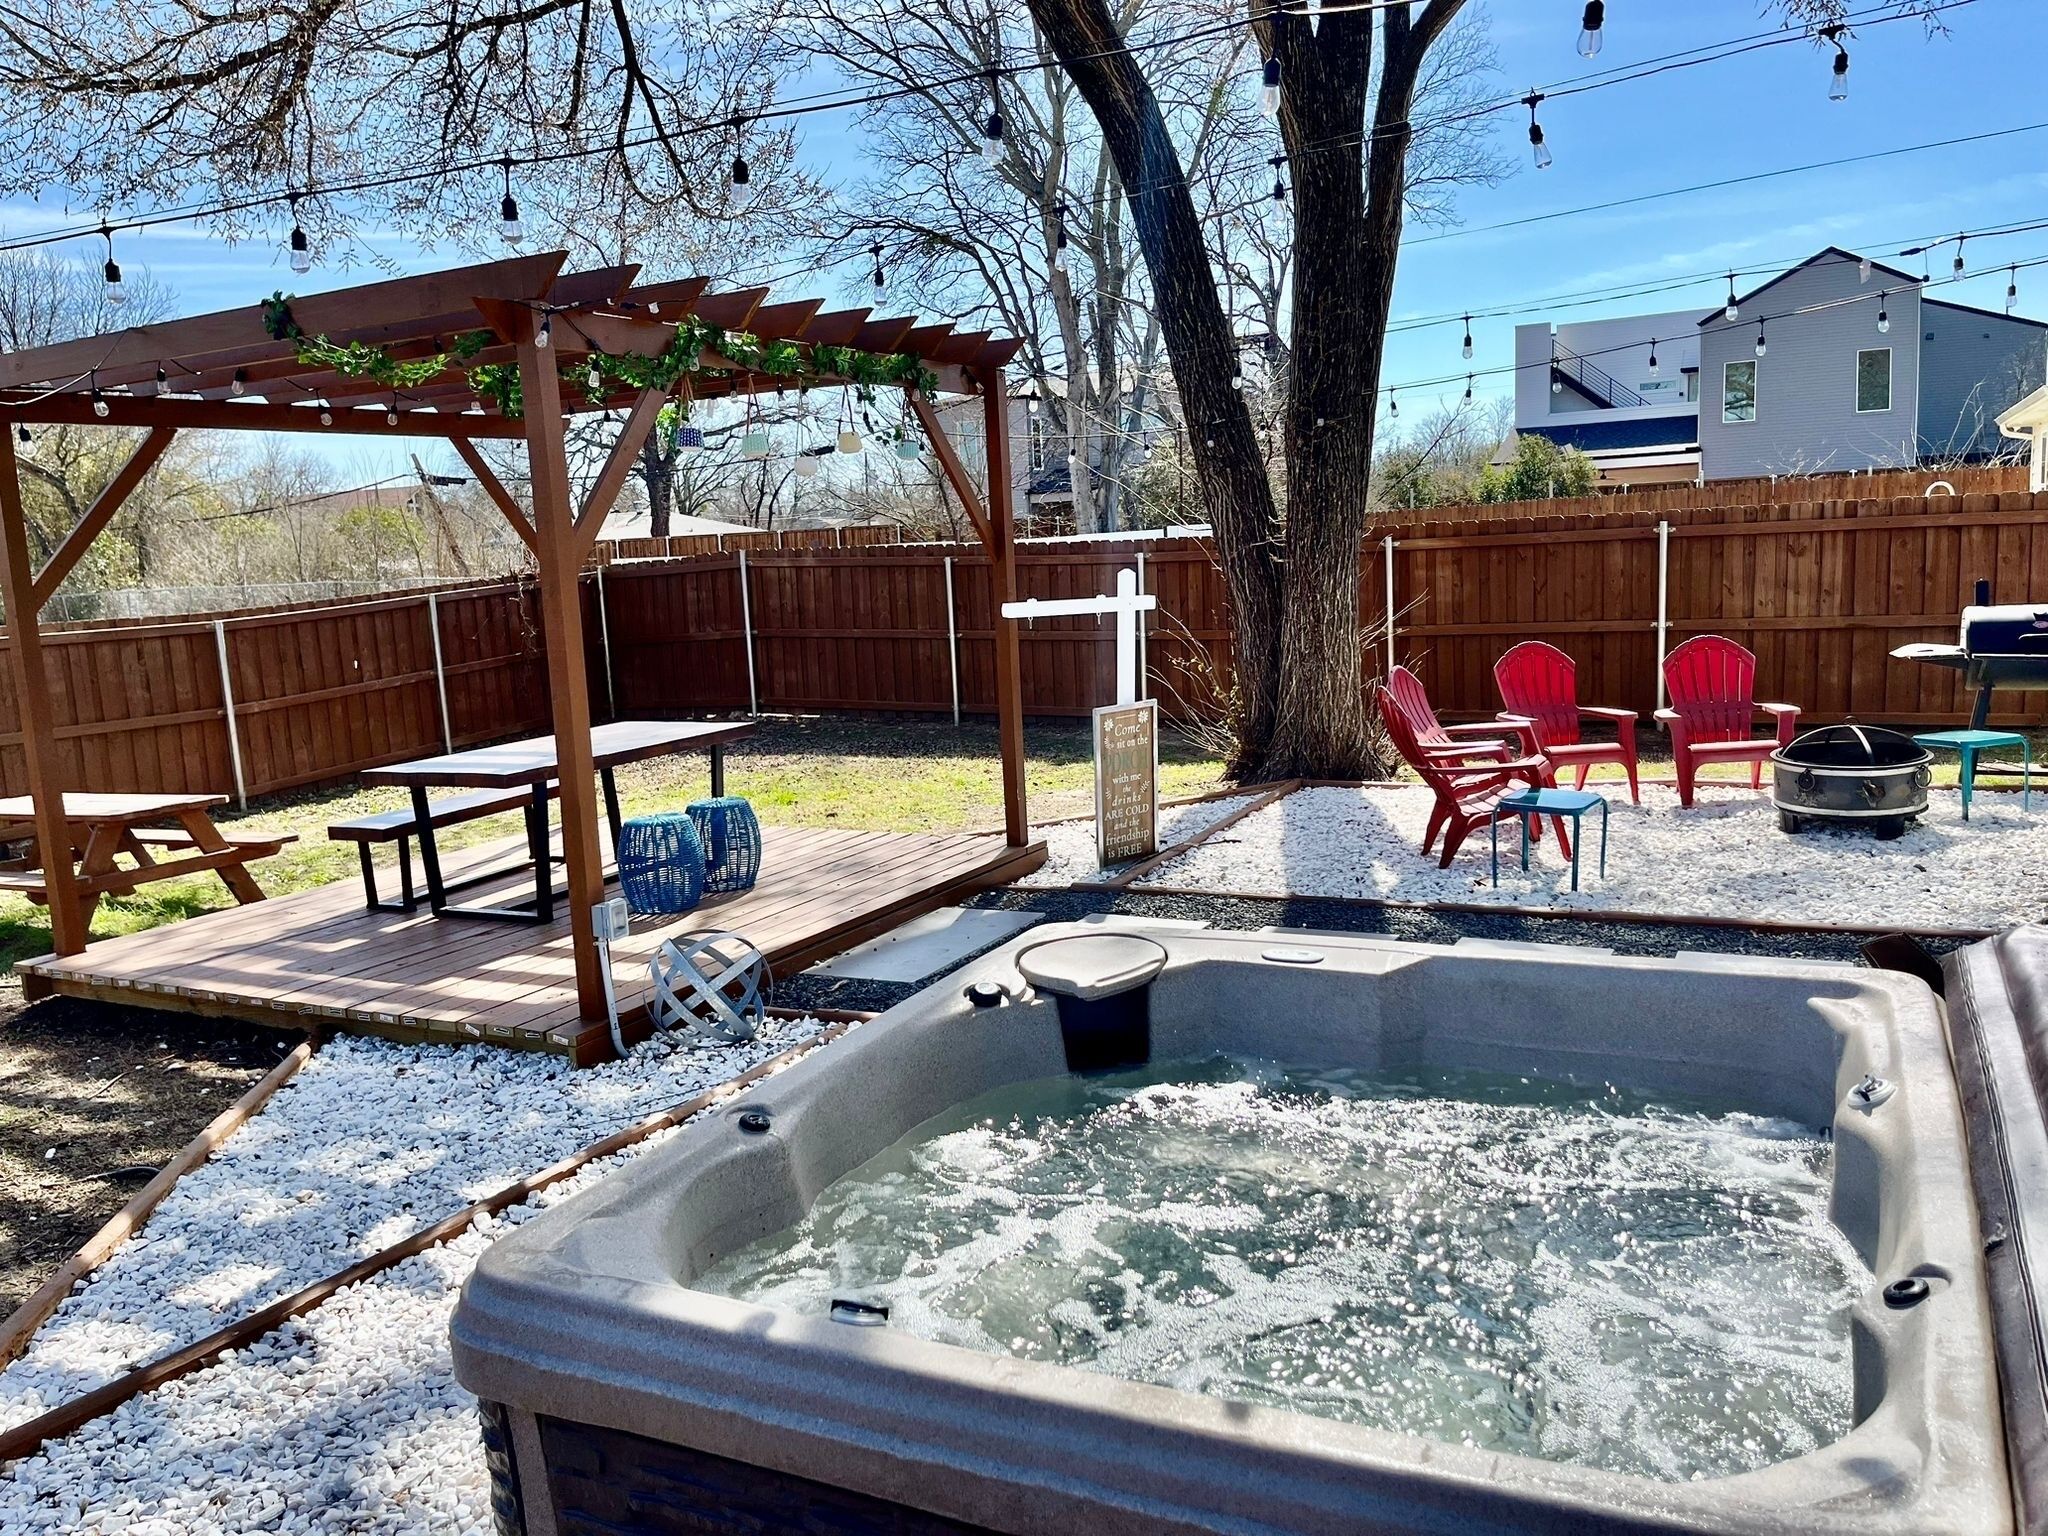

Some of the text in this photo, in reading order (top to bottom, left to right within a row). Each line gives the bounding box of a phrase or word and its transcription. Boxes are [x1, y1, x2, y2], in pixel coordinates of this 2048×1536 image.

[1114, 724, 1141, 736] Come
[1117, 734, 1148, 749] sit on the
[1112, 772, 1142, 784] with me
[1122, 784, 1132, 793] the
[1112, 792, 1142, 806] drinks
[1104, 803, 1149, 821] ARE COLD
[1113, 817, 1140, 830] and the
[1105, 828, 1150, 846] friendship
[1107, 843, 1142, 858] is FREE
